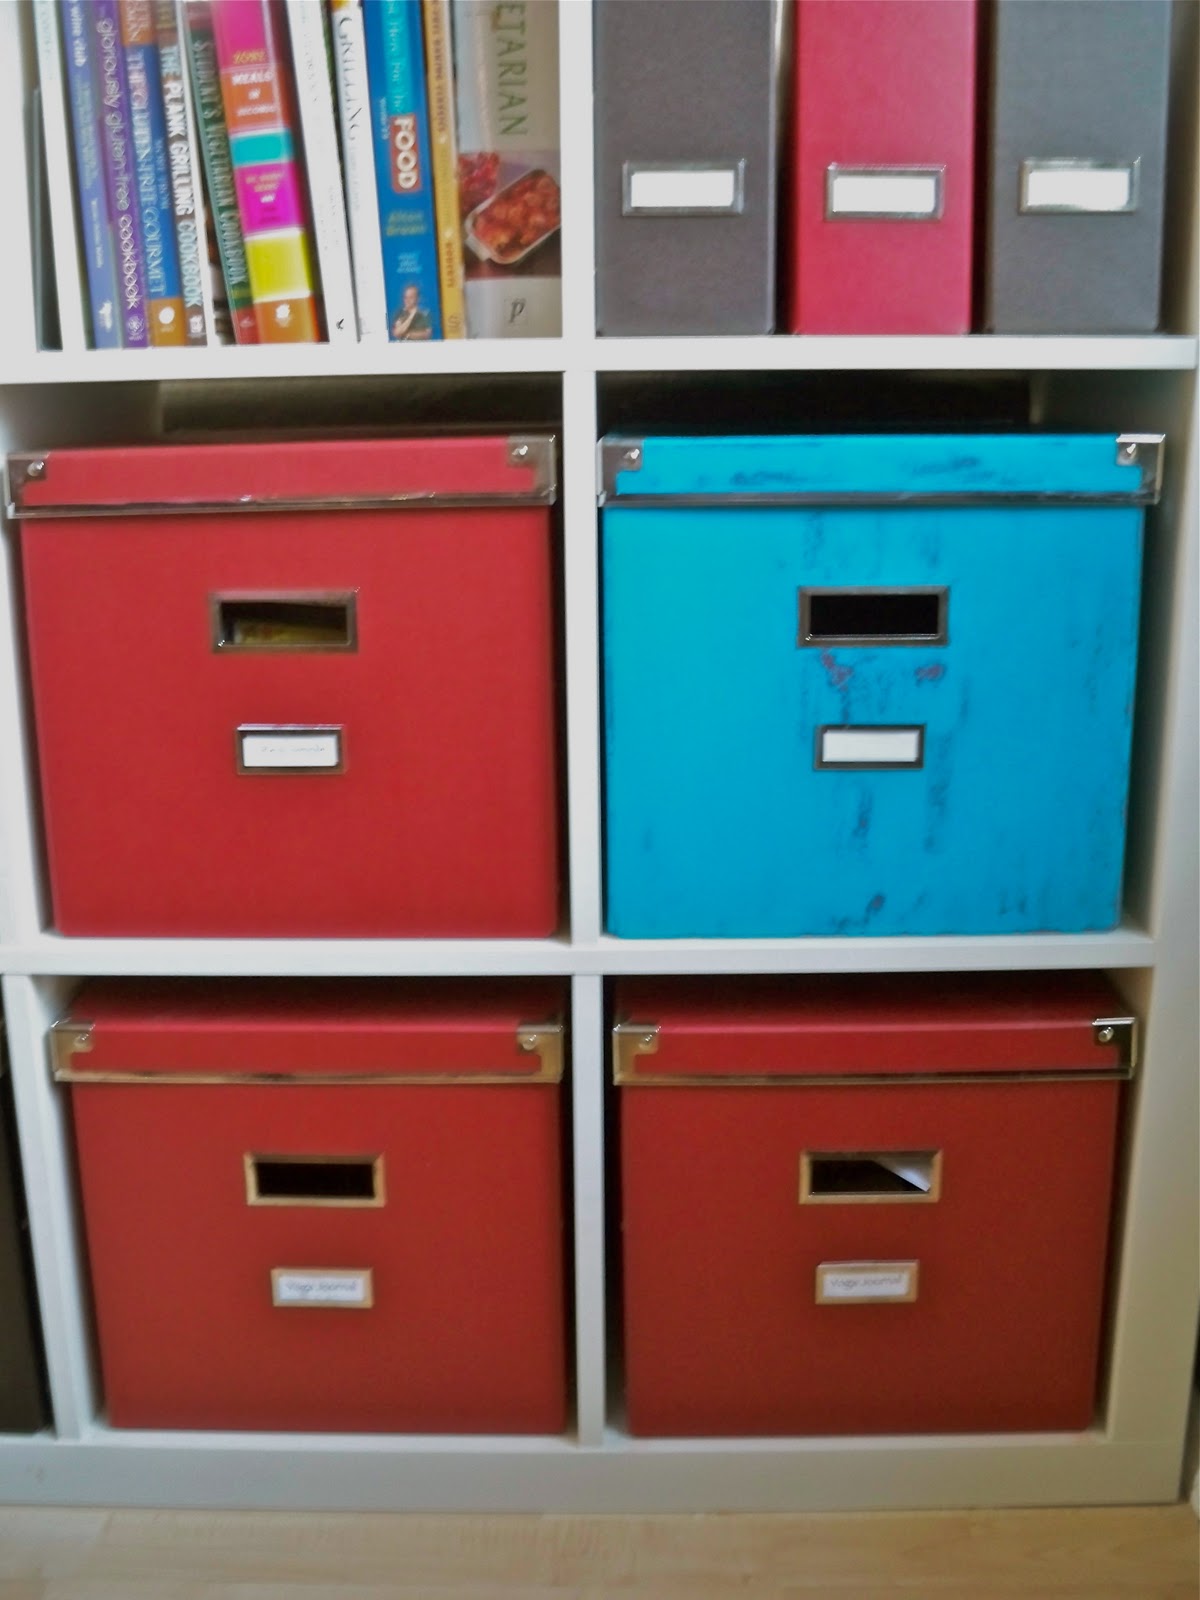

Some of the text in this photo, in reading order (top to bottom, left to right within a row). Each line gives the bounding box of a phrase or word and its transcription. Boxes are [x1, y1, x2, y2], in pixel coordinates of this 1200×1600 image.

[96, 17, 120, 108] gloriously
[160, 45, 181, 77] THE
[163, 79, 188, 139] PLANK
[393, 115, 419, 190] FOOD
[106, 110, 130, 211] gluten-free
[169, 140, 195, 217] GRILLING
[118, 213, 140, 310] cookbook
[141, 206, 166, 296] GOURMET
[177, 218, 203, 308] COOKBOOK
